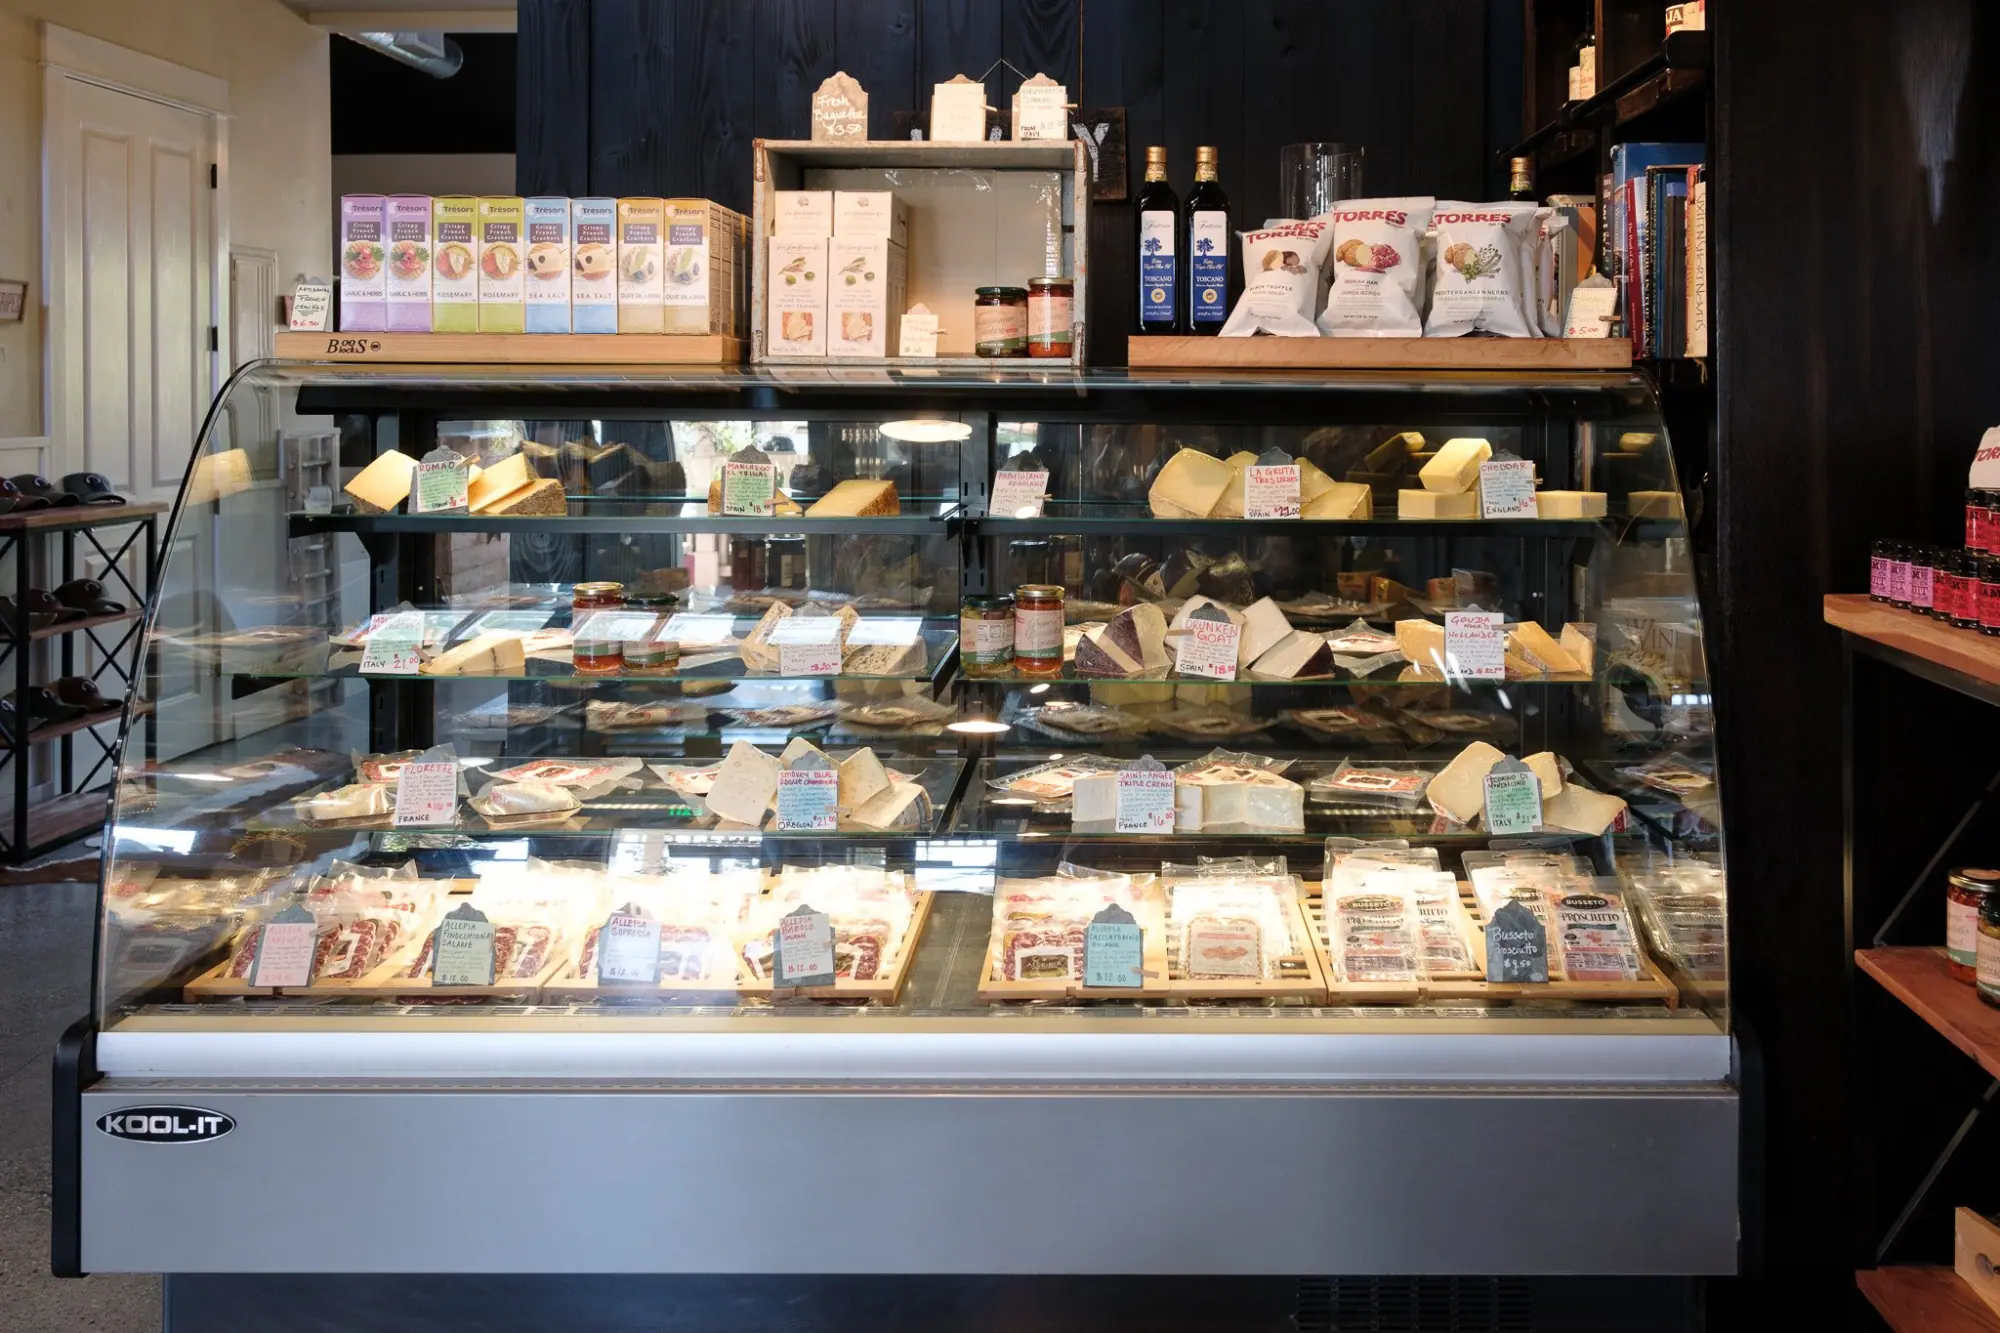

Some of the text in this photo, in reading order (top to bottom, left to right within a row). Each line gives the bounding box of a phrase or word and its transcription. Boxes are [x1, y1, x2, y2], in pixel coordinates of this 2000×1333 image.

[1333, 210, 1408, 226] TORRES
[1434, 213, 1513, 225] TORRES
[1245, 229, 1320, 245] TORRES
[727, 463, 771, 471] MANCHEGO
[1249, 467, 1261, 477] LA
[1481, 462, 1527, 472] CHEDDAR
[1486, 505, 1522, 514] ENGLAND
[1451, 615, 1490, 624] GOUDA
[1185, 620, 1238, 637] DRUNKEN
[1197, 631, 1236, 644] GOAT
[363, 660, 386, 668] ITALY
[1180, 663, 1204, 672] SPAIN
[403, 763, 453, 774] FLORETTE
[1145, 780, 1173, 788] CREAM
[398, 814, 430, 823] FRANCE
[1492, 819, 1512, 827] ITALY
[778, 821, 813, 830] OREGON
[1118, 821, 1148, 830] FRANCE
[1560, 912, 1620, 921] PROSCIUTTO
[444, 920, 476, 931] ALLEPIA
[611, 917, 647, 929] ALLEPIA
[1487, 926, 1534, 942] Busseto
[105, 1115, 223, 1134] KOOL-IT
